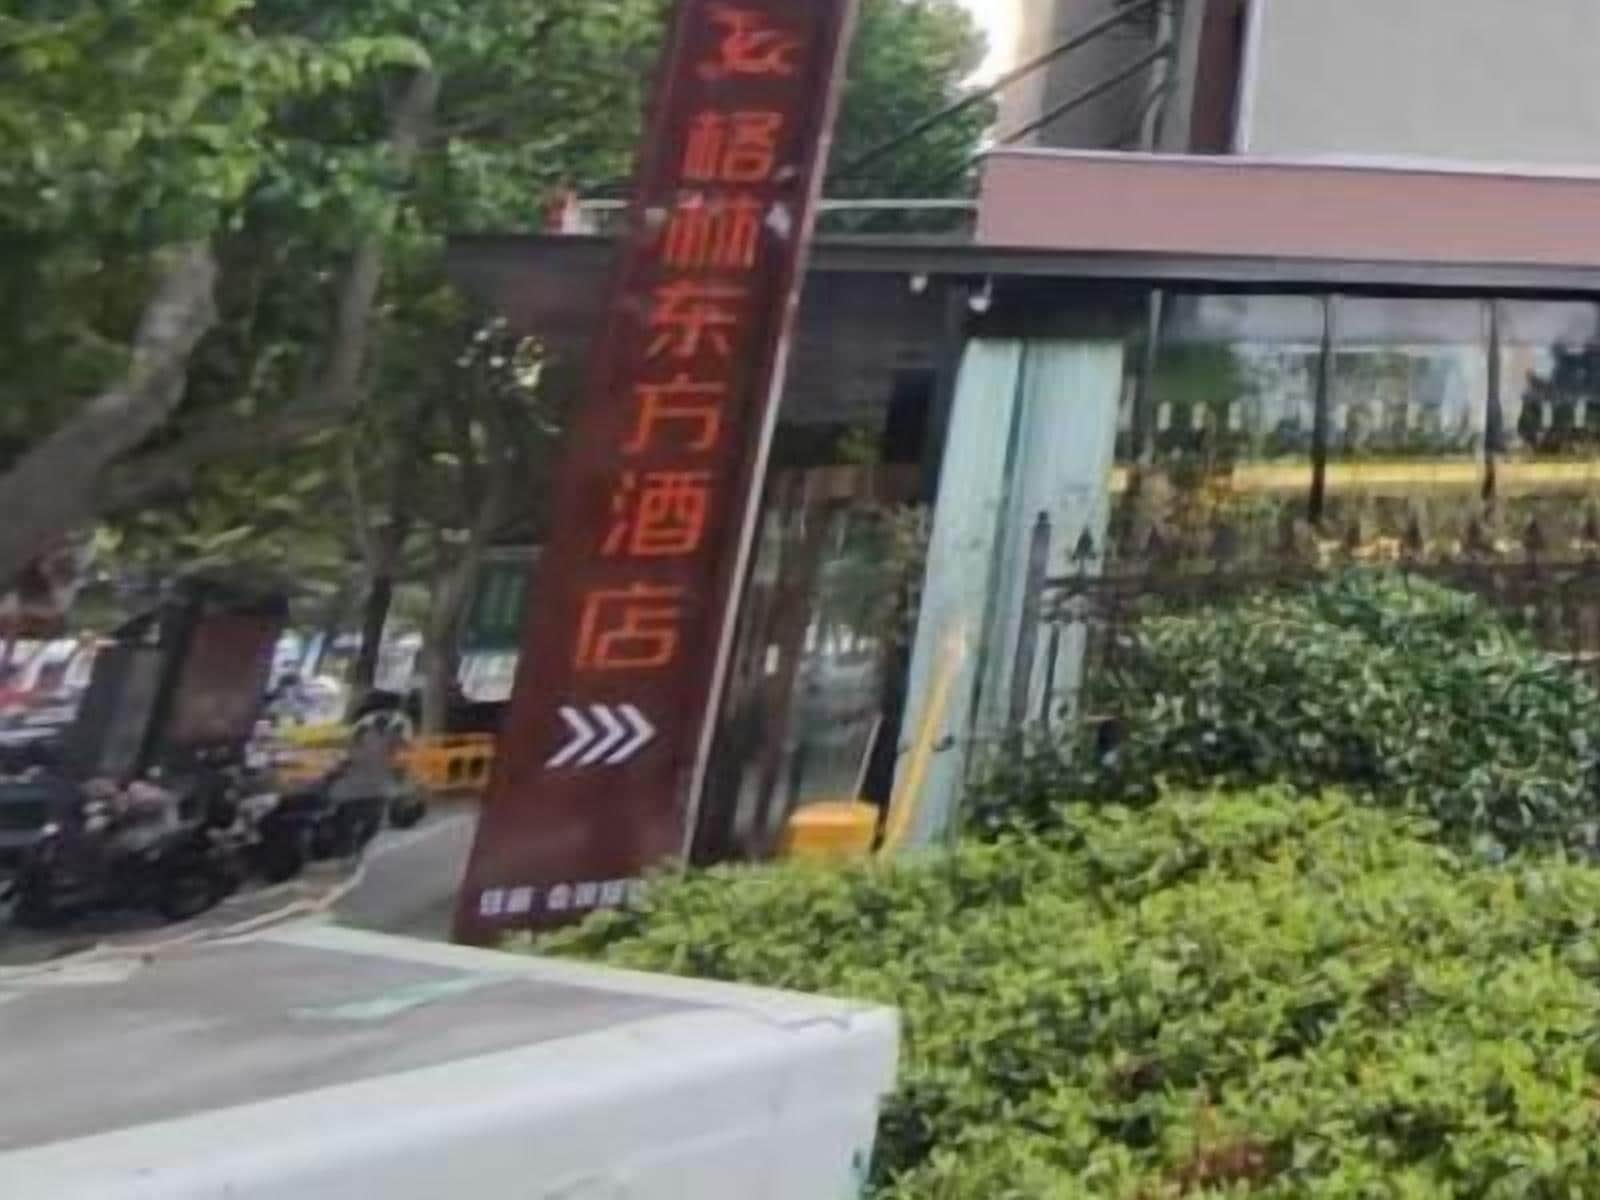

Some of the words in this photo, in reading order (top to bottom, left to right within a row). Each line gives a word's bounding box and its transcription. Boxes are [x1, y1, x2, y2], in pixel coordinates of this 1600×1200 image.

[573, 110, 786, 670] 格林东方酒店
